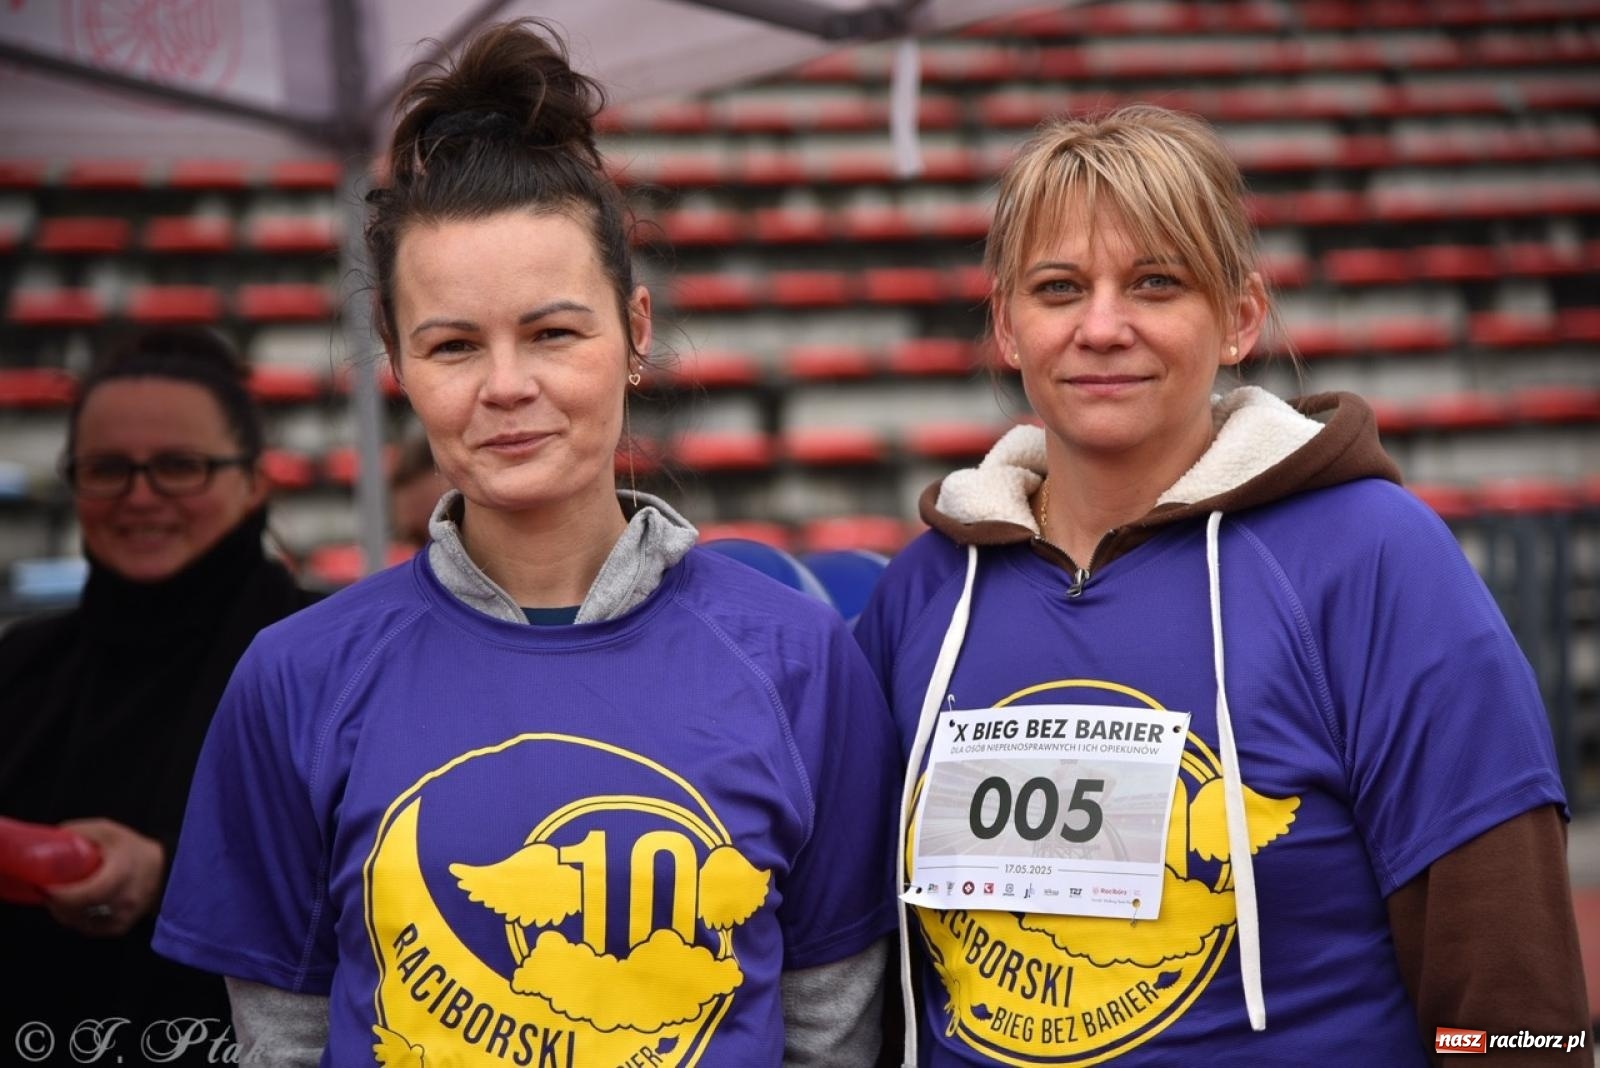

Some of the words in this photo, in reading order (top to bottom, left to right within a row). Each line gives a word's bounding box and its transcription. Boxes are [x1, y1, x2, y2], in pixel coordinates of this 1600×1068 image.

[973, 721, 1018, 740] BIEG
[1026, 719, 1068, 739] BEZ
[1075, 719, 1164, 743] BARIER
[987, 743, 1076, 752] NIEPEŁNOSPRAWNYCH
[1100, 744, 1160, 755] OPIEKUNÓW
[969, 776, 1105, 843] 005
[1005, 864, 1052, 875] 17.05.2025
[392, 922, 576, 1068] RACIBORSKI
[990, 1006, 1034, 1043] BIEG
[1041, 1016, 1078, 1044] BEZ
[1081, 980, 1159, 1037] BARIER
